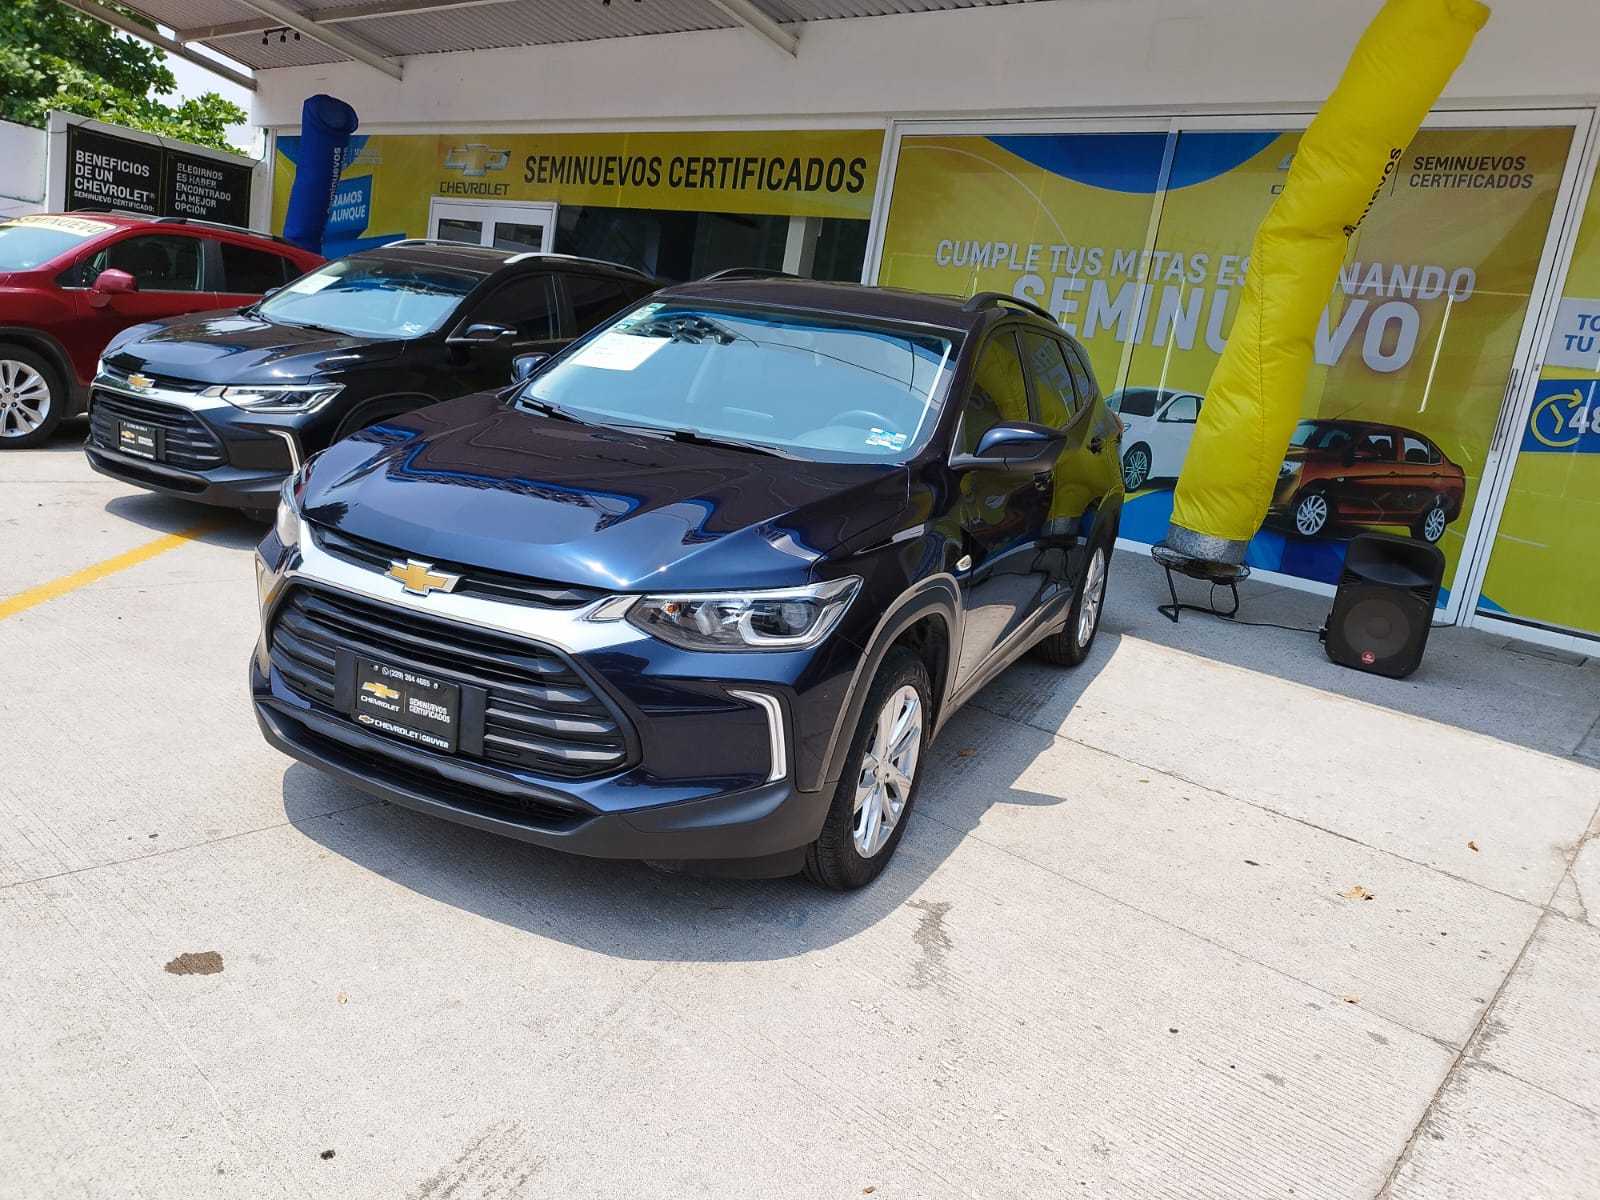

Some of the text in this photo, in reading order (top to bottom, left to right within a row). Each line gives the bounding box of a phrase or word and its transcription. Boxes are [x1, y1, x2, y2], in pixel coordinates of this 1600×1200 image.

[76, 150, 150, 177] BENEFICIOS
[176, 162, 223, 180] ELEGIRNOS
[1413, 155, 1527, 171] SEMINUEVOS
[75, 164, 113, 182] DE UN
[176, 172, 217, 189] ES HABER
[523, 155, 867, 195] SEMINUEVOS CERTIFICADOS
[1409, 173, 1534, 189] CERTIFICADOS
[73, 190, 112, 204] SEMINUEVO
[176, 182, 231, 201] ENCONTRADO
[439, 181, 511, 196] CHEVROLET
[174, 202, 206, 215] OPCIÓN
[175, 192, 217, 208] LA MEJOR
[936, 239, 1043, 272] CUMPLE
[1050, 245, 1104, 276] TUS
[1110, 249, 1209, 285] METAS
[1012, 275, 1420, 373] SEMINUVO
[1564, 334, 1594, 352] TU
[360, 695, 400, 712] CHEVROLET
[409, 698, 447, 714] SEMINUEVOS
[409, 705, 450, 723] CERTIFICADOS
[374, 720, 419, 739] CHEVROLET
